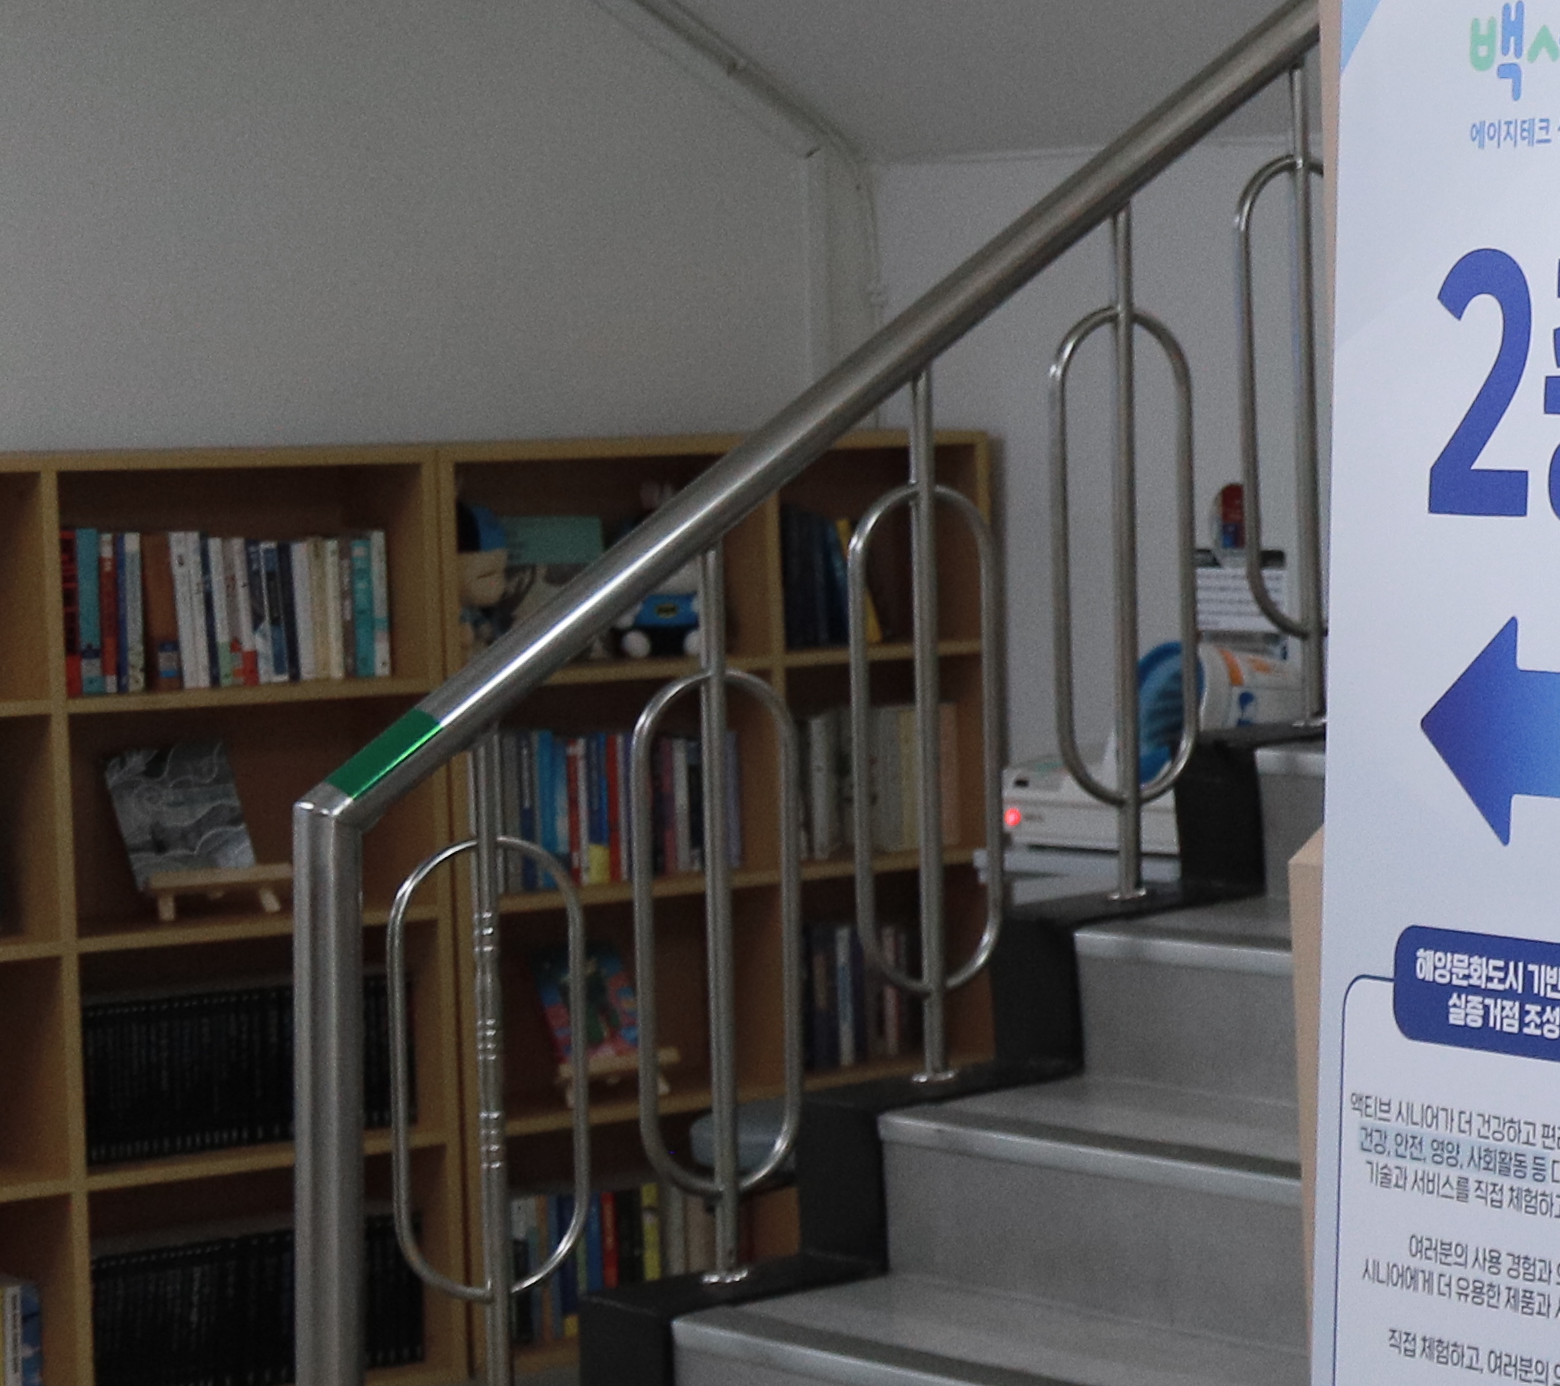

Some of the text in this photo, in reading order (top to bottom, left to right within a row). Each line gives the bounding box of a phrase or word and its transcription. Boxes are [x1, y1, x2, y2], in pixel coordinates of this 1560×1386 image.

[1470, 113, 1552, 150] 에이지테크
[1415, 947, 1524, 995] 해양문화도시
[1447, 992, 1520, 1034] 실증거점
[1523, 1004, 1560, 1038] 조성
[1351, 1091, 1392, 1123] 액티브
[1394, 1097, 1454, 1133] 시니어가
[1457, 1110, 1473, 1138] 더
[1476, 1112, 1537, 1148] 건강하고
